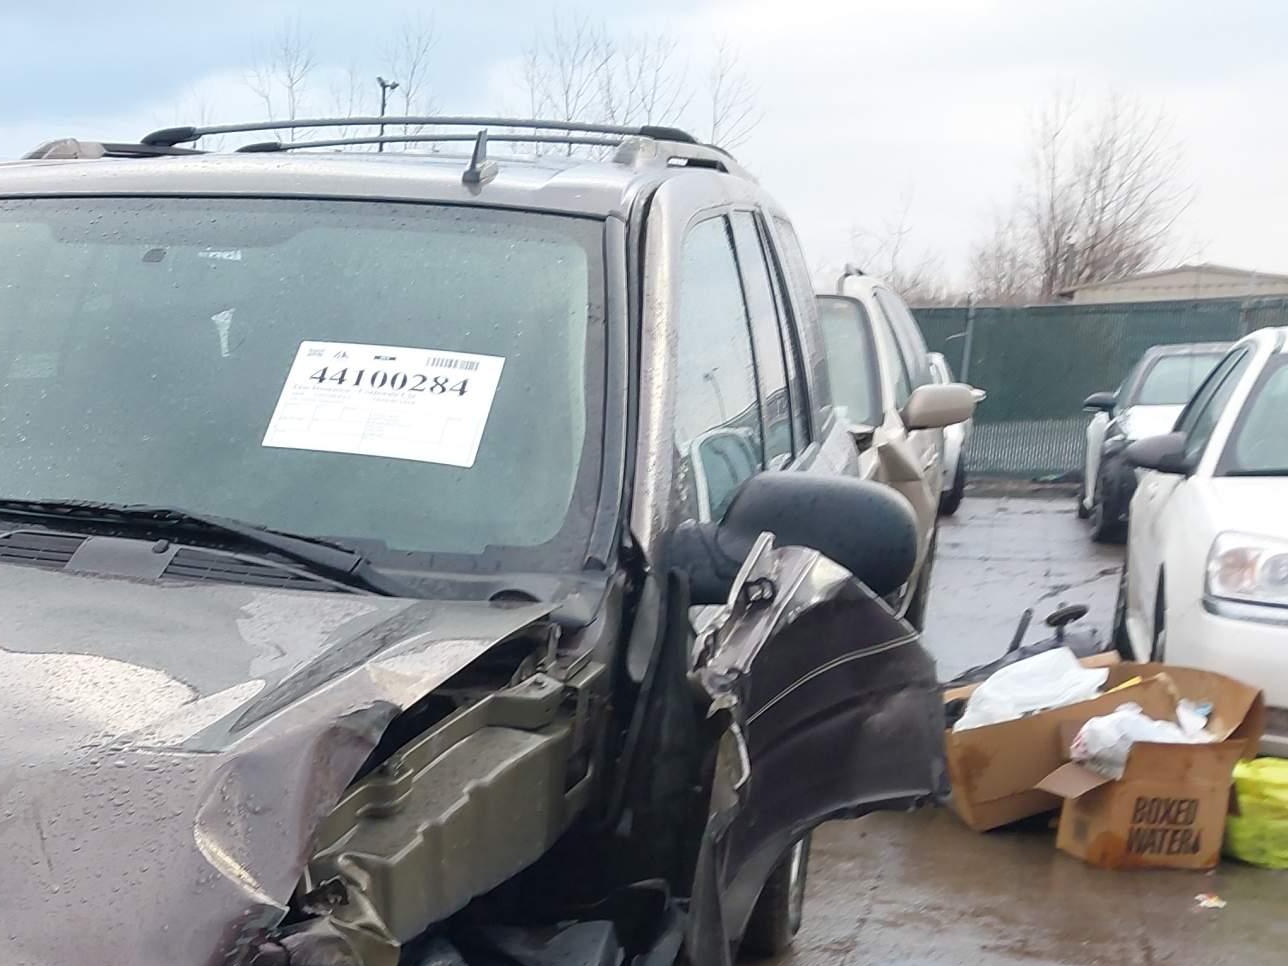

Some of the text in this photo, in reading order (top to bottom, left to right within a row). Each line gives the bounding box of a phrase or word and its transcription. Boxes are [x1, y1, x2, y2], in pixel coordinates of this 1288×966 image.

[309, 365, 471, 398] 44100284
[1131, 796, 1200, 824] BOXED
[1127, 827, 1193, 855] WATER
